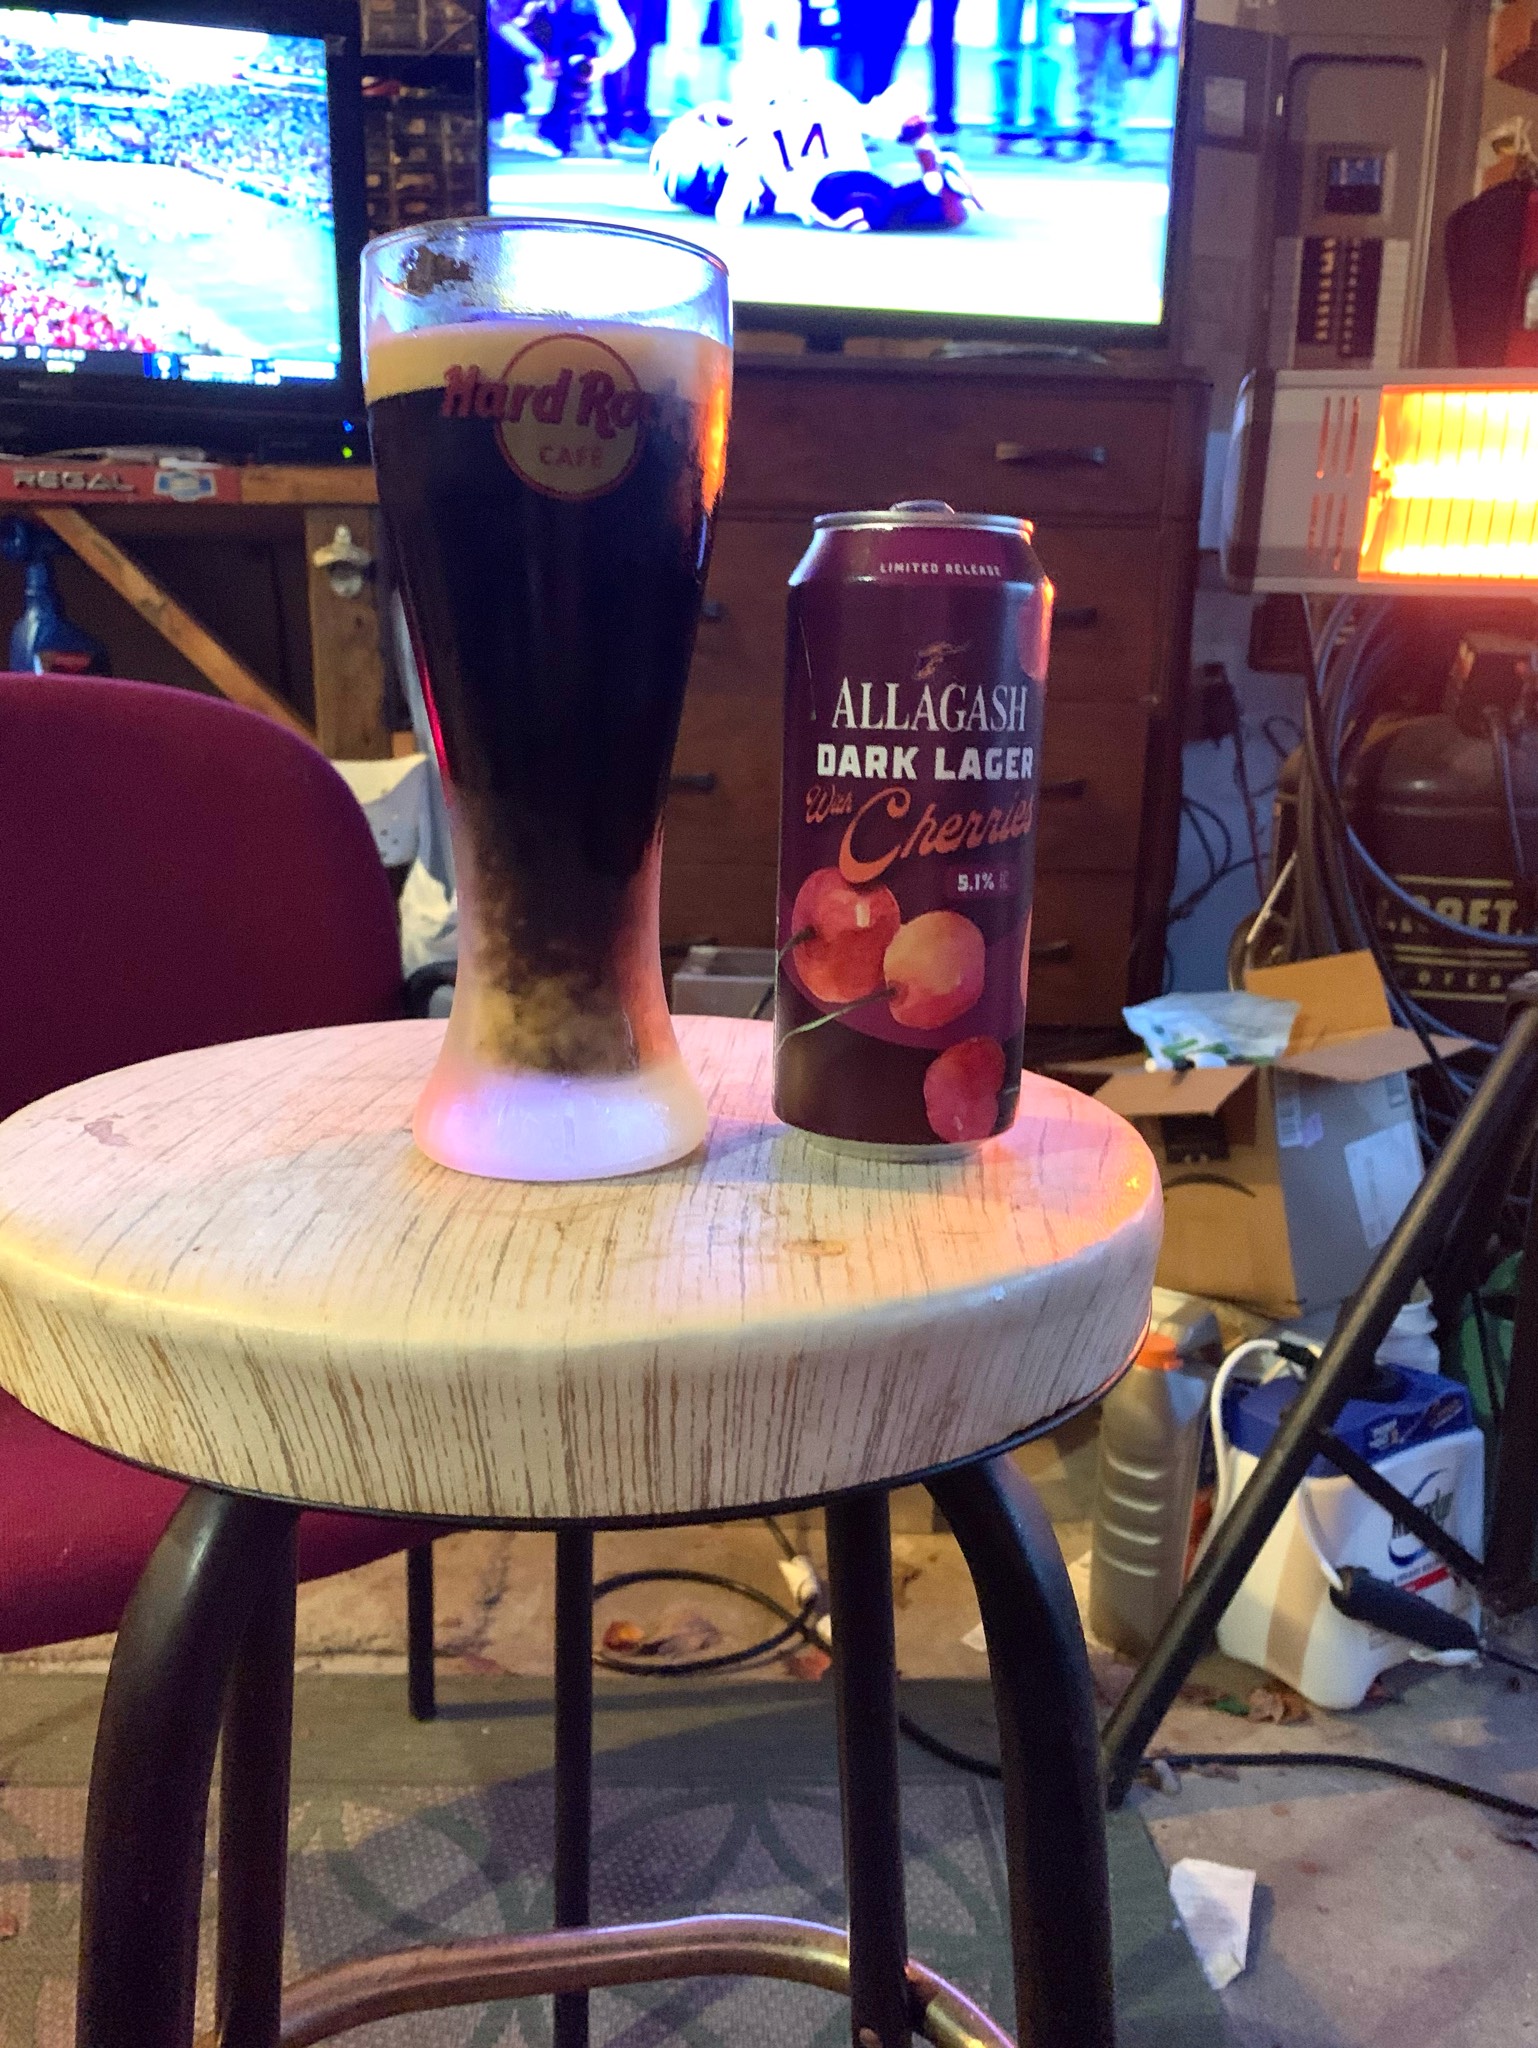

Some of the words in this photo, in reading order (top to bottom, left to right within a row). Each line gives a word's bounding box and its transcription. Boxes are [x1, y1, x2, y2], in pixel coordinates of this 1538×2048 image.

[441, 364, 573, 425] Hard
[13, 470, 136, 492] REGAL
[880, 562, 939, 574] LIMITED
[945, 563, 1002, 577] RELEASE
[831, 675, 1029, 733] ALLAGASH
[816, 743, 919, 780] DARK
[934, 746, 1034, 780] LAGER
